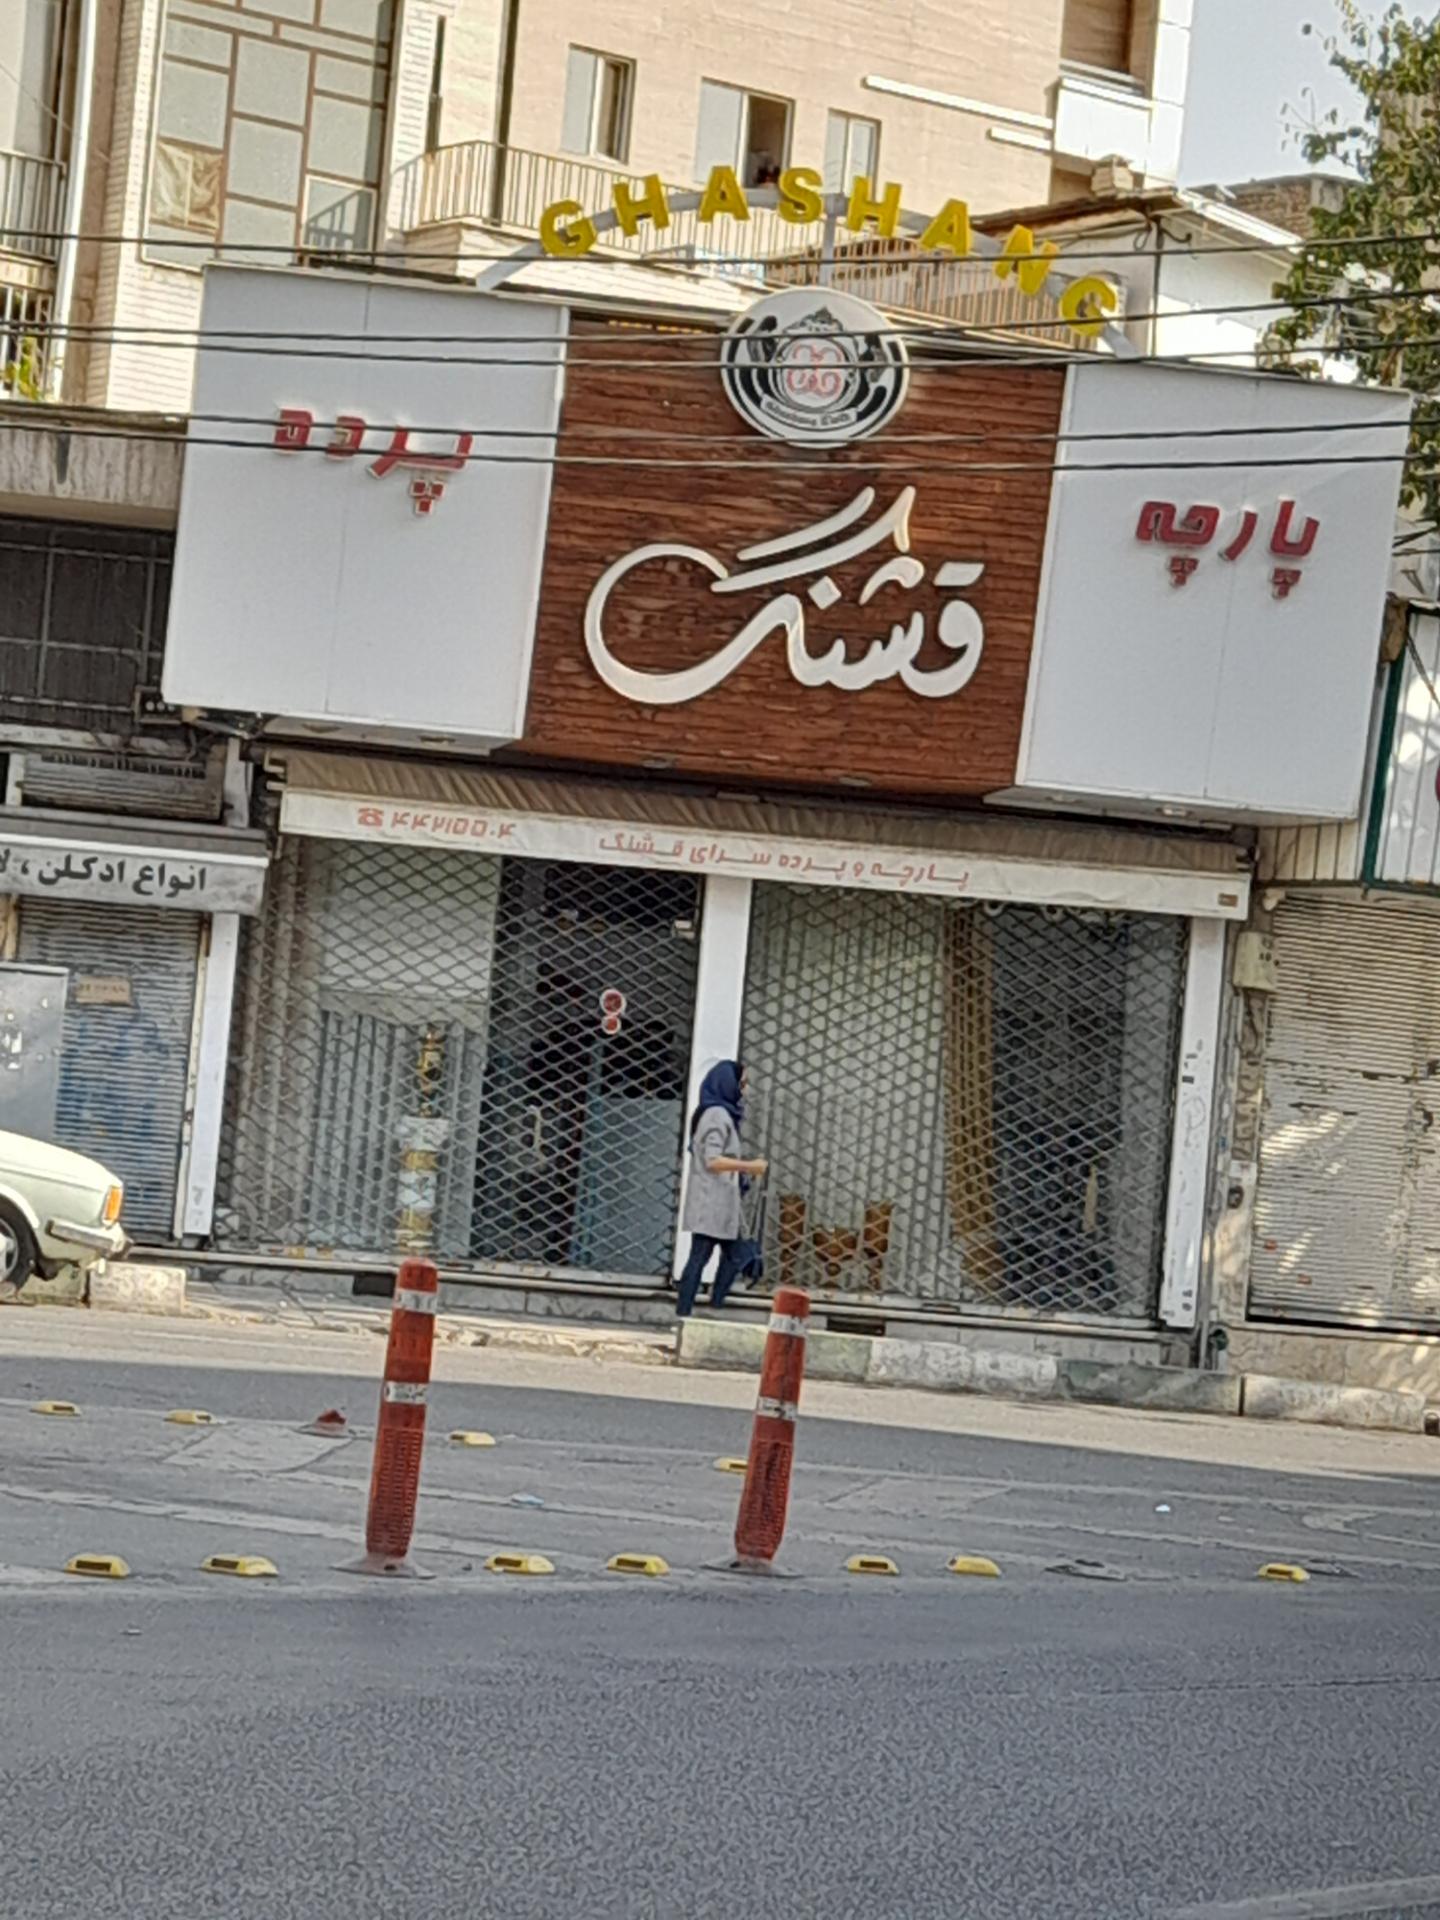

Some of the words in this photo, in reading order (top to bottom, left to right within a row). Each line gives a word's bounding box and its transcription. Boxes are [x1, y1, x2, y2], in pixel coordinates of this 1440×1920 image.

[540, 166, 1118, 337] GHASHANG
[274, 408, 473, 516] پرده
[1135, 500, 1320, 600] پارچه
[584, 485, 985, 704] قشنگ
[599, 832, 685, 857] قشنگ
[689, 843, 772, 866] سرای
[132, 863, 206, 898] انواع
[778, 854, 847, 881] پرده
[852, 861, 865, 879] و
[870, 862, 969, 892] پارچه
